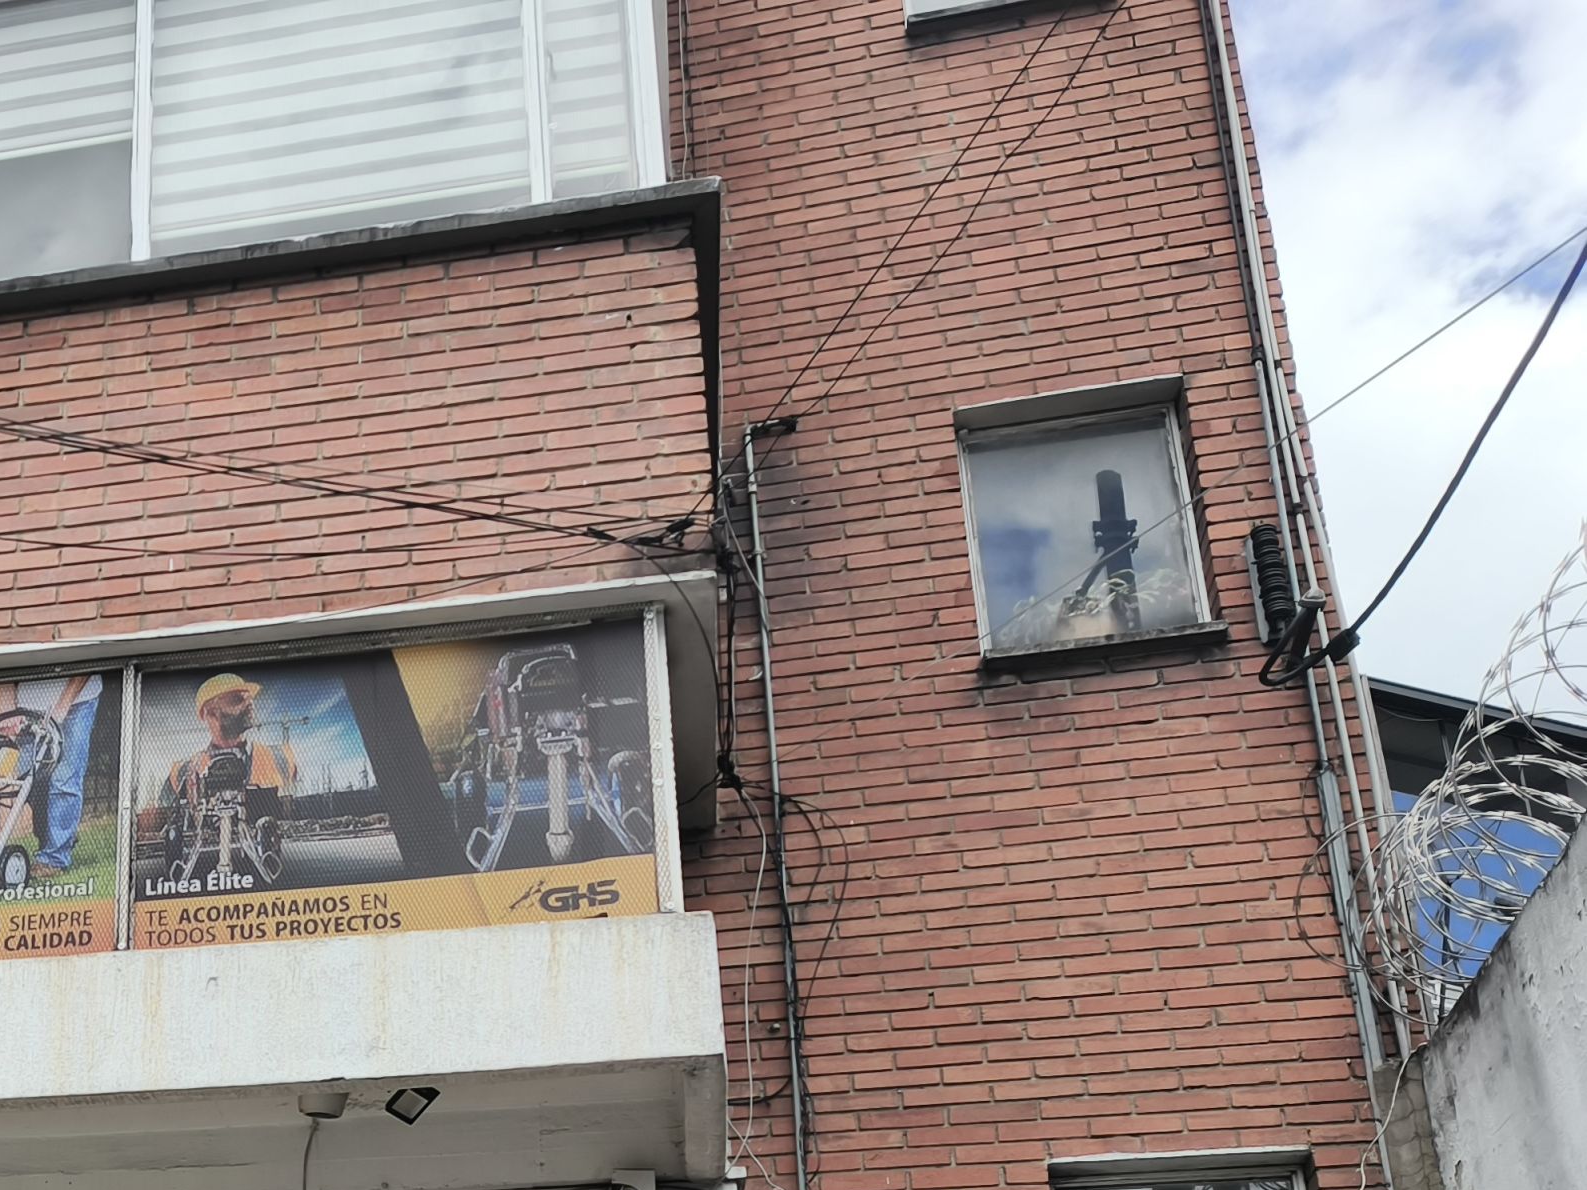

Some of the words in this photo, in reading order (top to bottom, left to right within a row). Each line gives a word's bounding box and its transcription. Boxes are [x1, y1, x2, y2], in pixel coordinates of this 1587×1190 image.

[145, 877, 202, 896] Línea
[206, 869, 254, 891] Élite
[539, 879, 620, 913] GHS
[9, 910, 93, 932] SIEMPRE
[145, 911, 168, 927] TE
[178, 896, 350, 924] ACOMPAÑAMOS
[361, 893, 388, 911] EN
[4, 930, 93, 951] CALIDAD
[145, 926, 216, 947] TODOS
[226, 922, 267, 941] TUS
[275, 912, 402, 938] PROYECTOS
